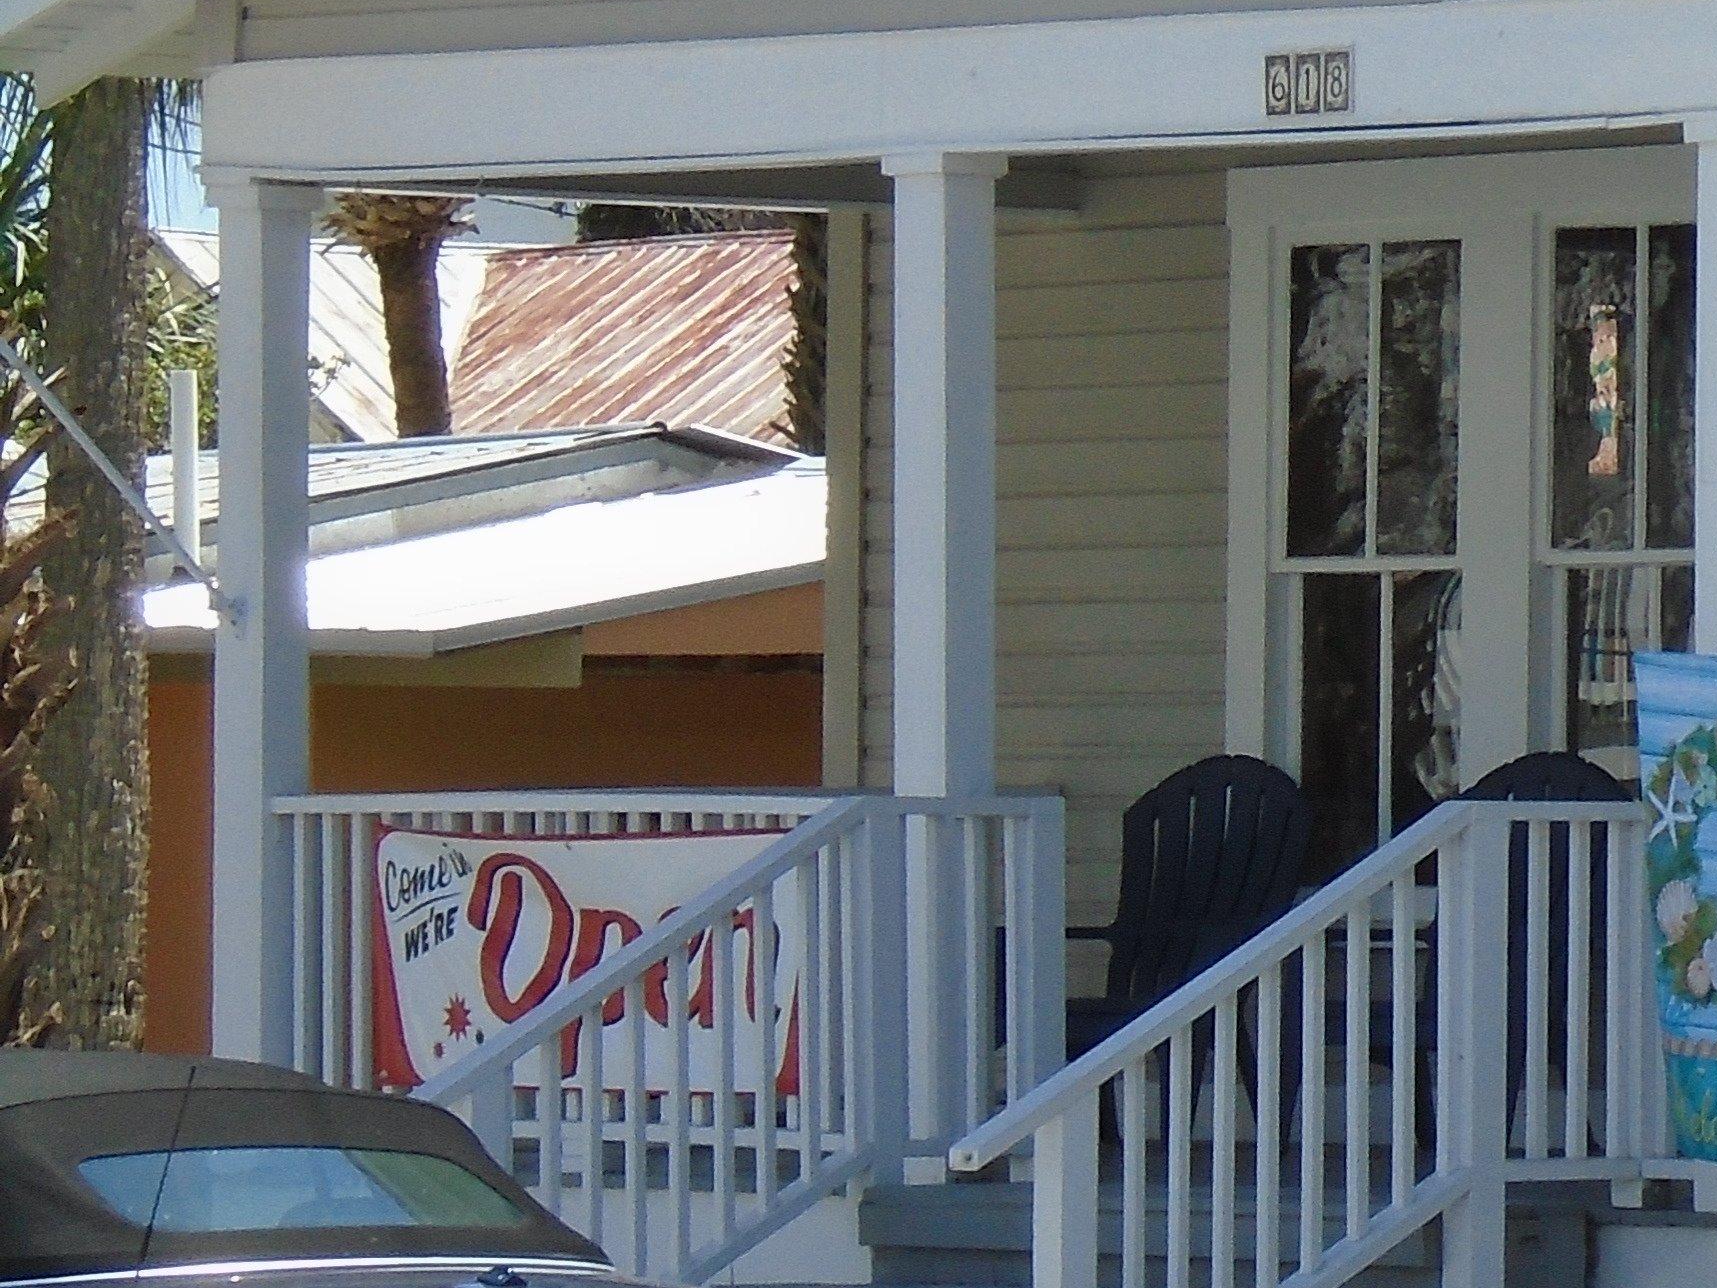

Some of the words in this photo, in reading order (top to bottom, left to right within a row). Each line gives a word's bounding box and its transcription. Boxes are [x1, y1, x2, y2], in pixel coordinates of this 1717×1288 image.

[1271, 64, 1343, 103] 618
[385, 854, 452, 912] Come
[404, 906, 459, 963] WE'RE
